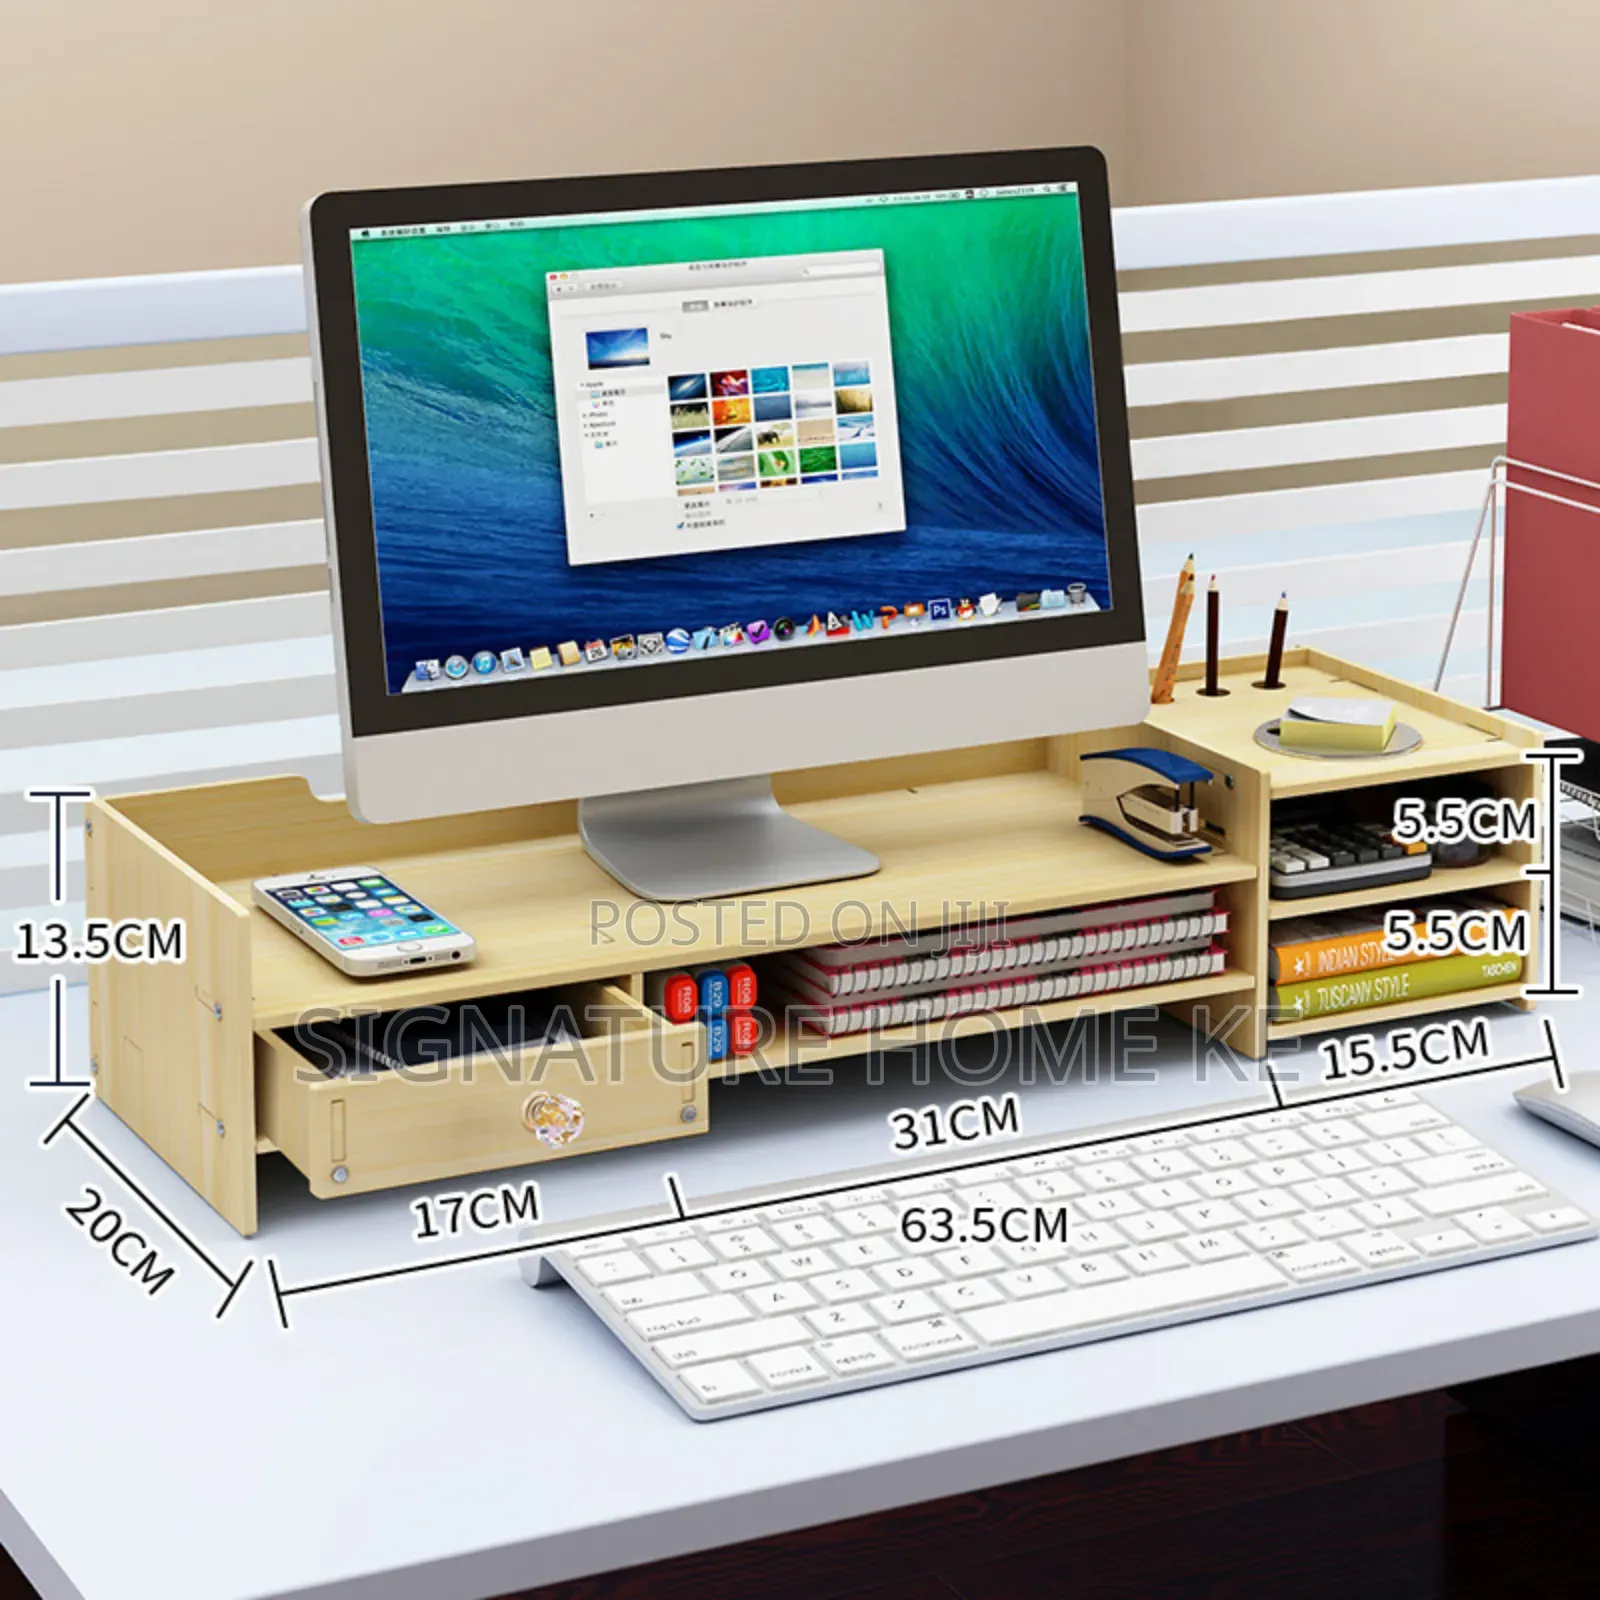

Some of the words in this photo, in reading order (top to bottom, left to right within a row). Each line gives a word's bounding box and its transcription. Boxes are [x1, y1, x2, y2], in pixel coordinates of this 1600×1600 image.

[851, 609, 875, 632] W
[1317, 944, 1359, 973] INDIAN
[1316, 980, 1373, 1011] TUSCANY
[1373, 972, 1410, 1002] STYLE
